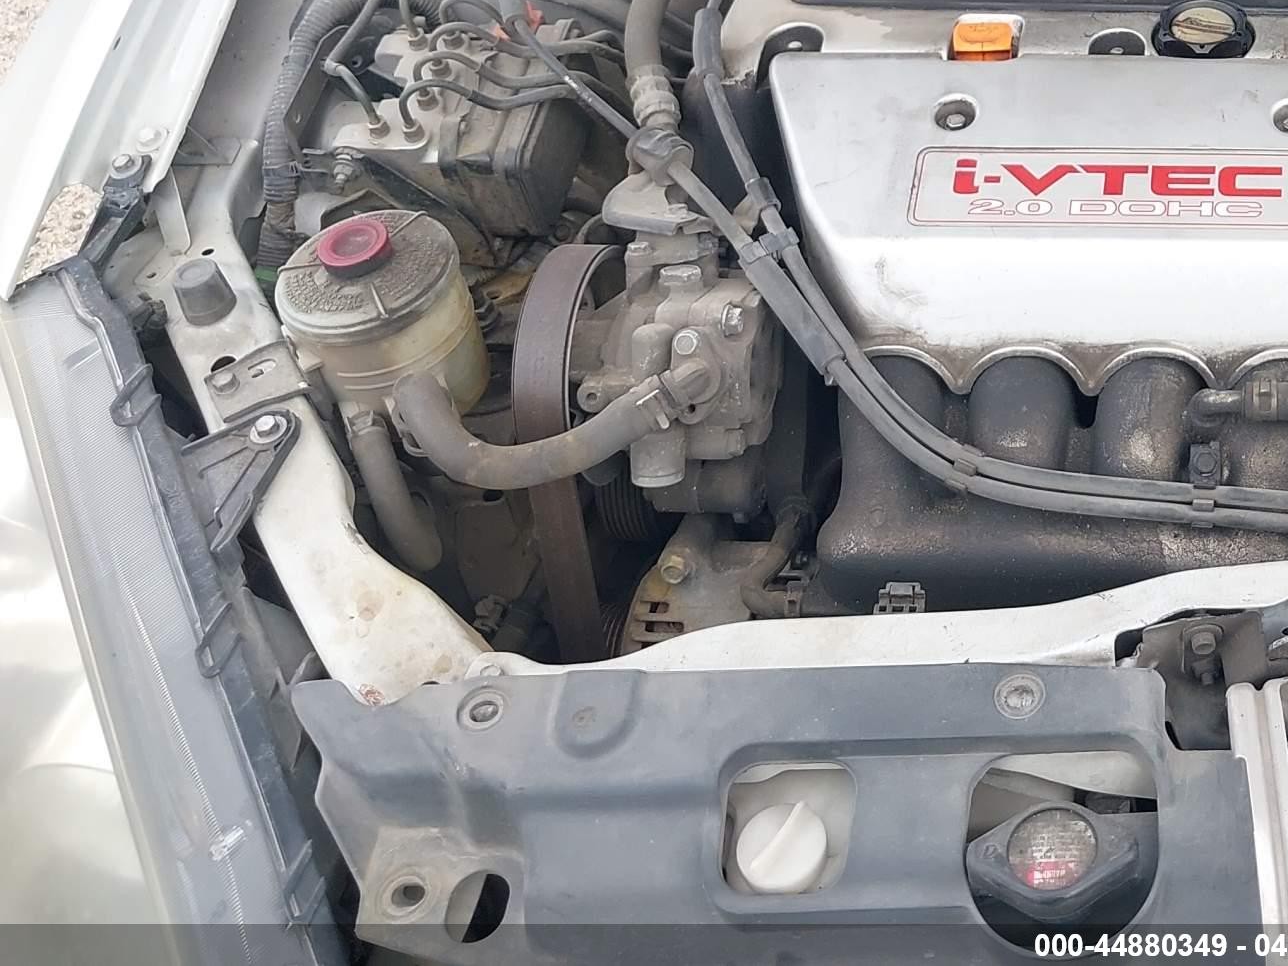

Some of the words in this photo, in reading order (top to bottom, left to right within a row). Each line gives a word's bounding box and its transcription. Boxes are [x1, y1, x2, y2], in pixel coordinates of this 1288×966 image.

[952, 159, 1284, 197] i-VTEC
[968, 198, 1053, 216] 2.0
[1069, 199, 1263, 218] DOHC
